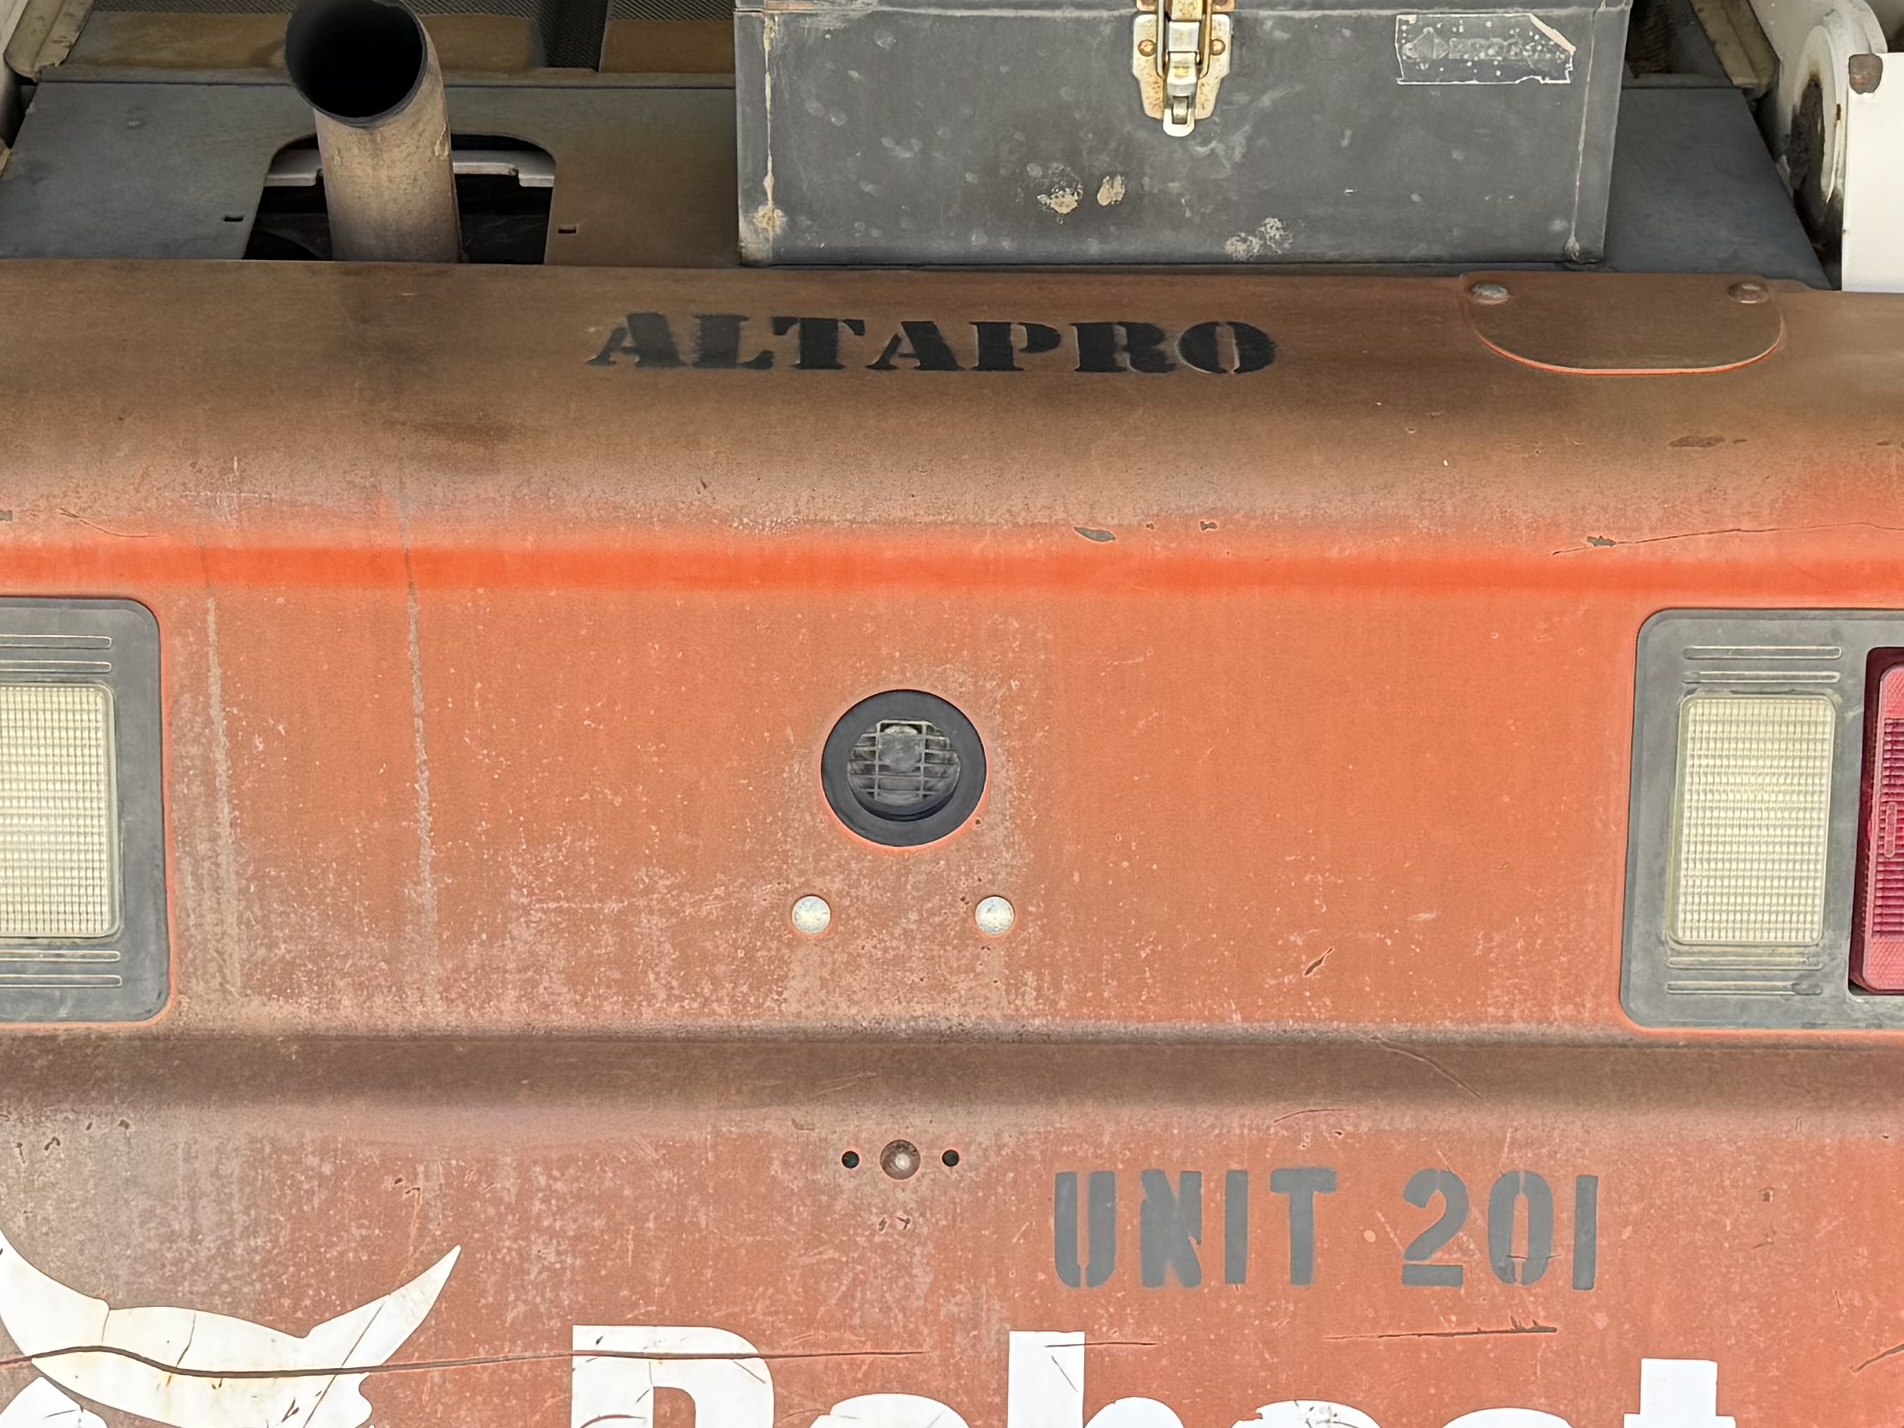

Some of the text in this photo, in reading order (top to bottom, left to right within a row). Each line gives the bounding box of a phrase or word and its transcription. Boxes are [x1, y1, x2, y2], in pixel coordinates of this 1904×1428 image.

[591, 312, 1276, 374] ALTAPRO
[1053, 1166, 1597, 1290] UNIT 201
